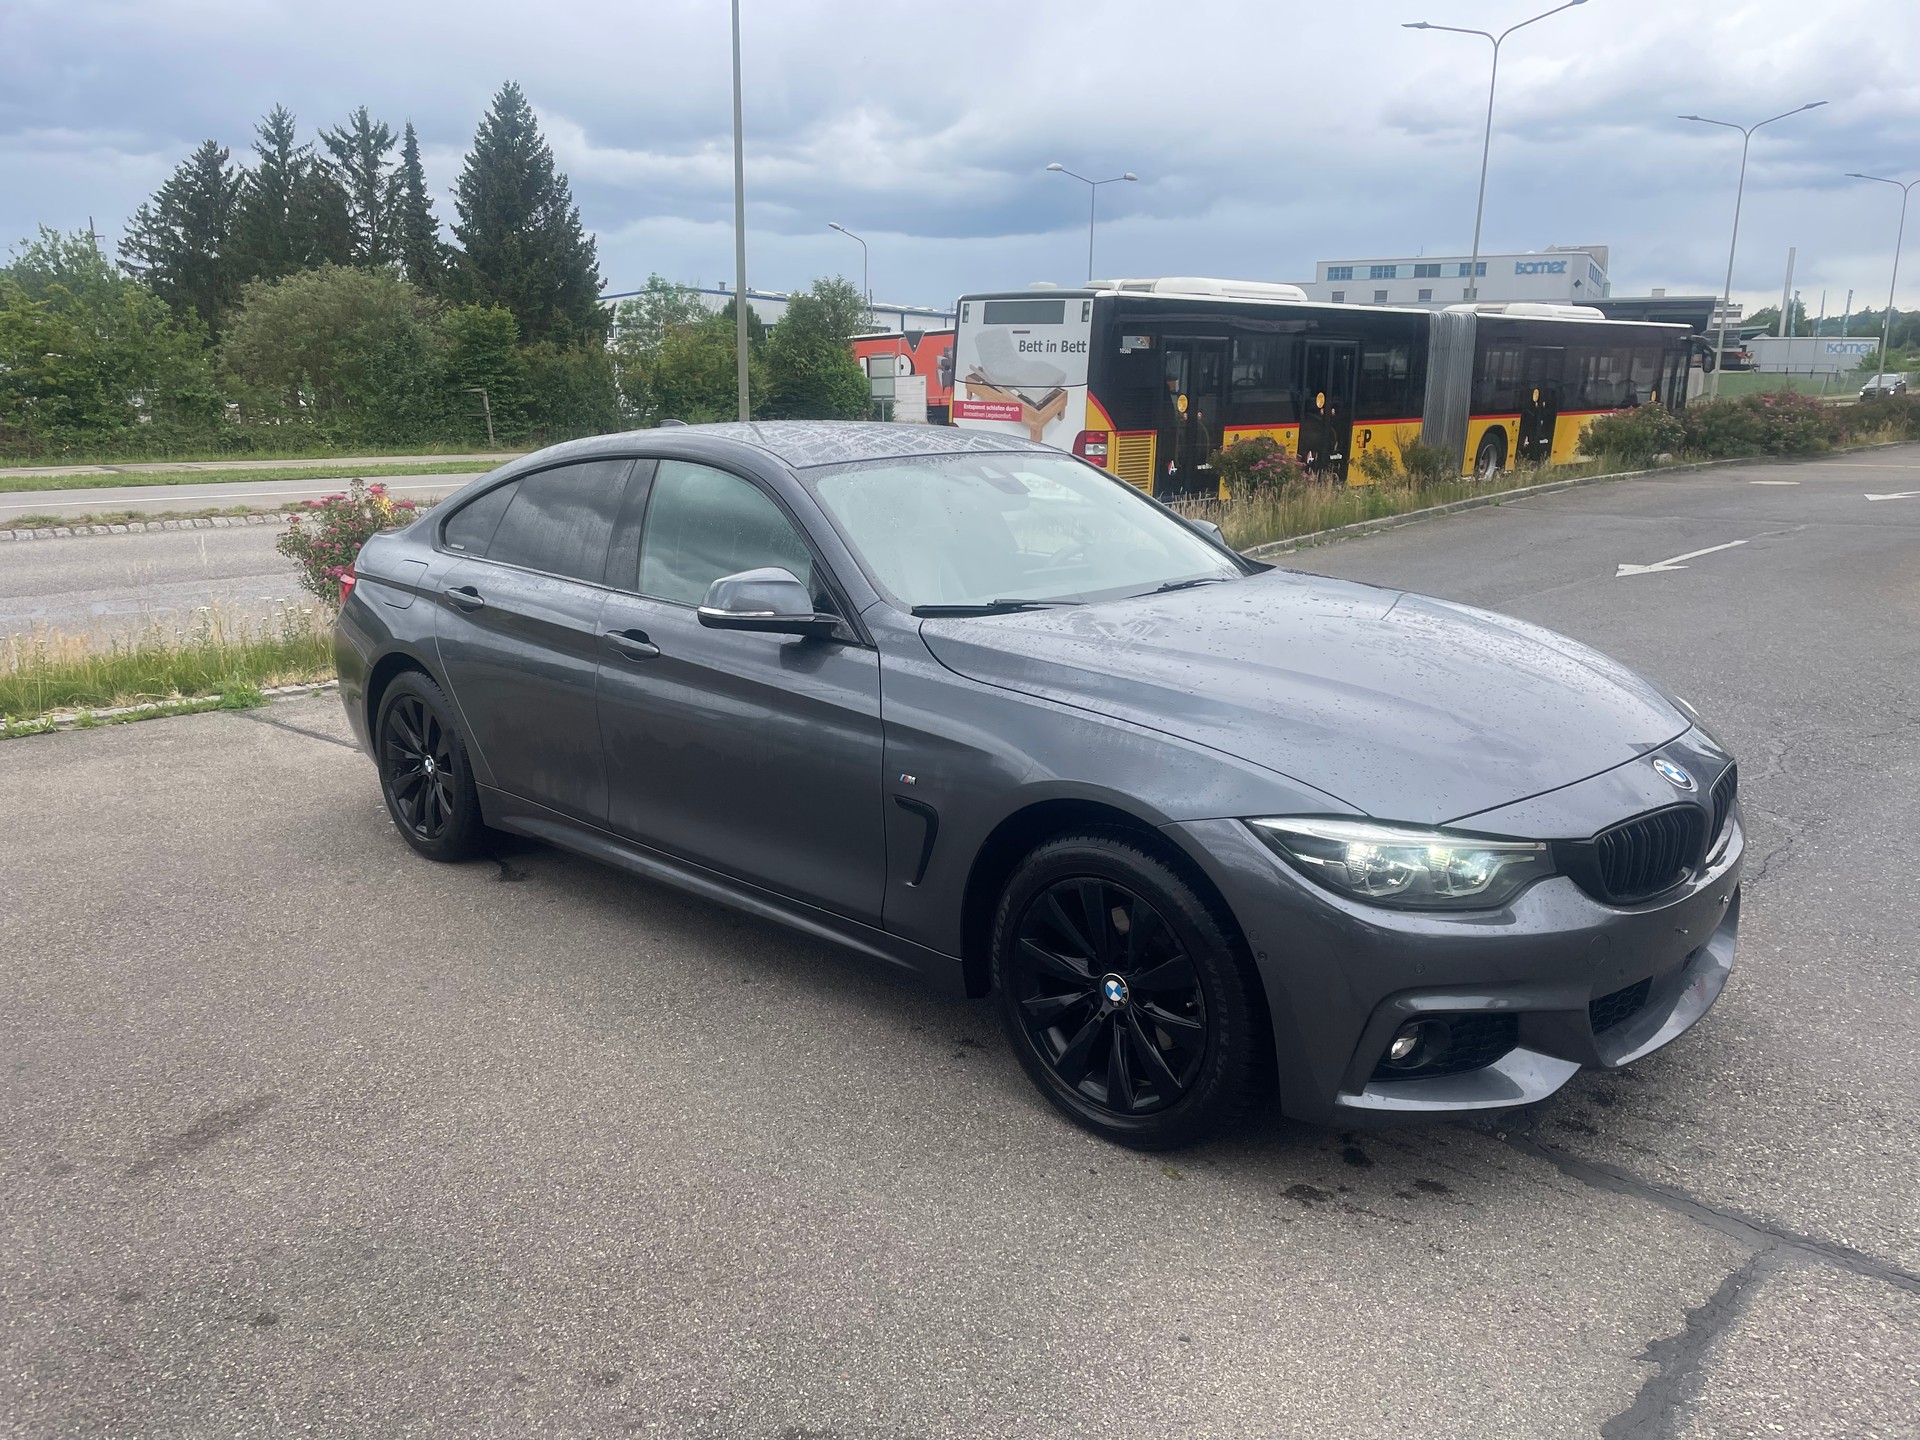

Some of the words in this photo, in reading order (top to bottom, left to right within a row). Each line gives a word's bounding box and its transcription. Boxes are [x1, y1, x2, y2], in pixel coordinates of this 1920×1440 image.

[1019, 340, 1043, 353] Bett
[1046, 340, 1057, 353] in
[1061, 340, 1087, 353] Bett
[1168, 460, 1178, 475] A
[992, 894, 1011, 989] DUNLOP
